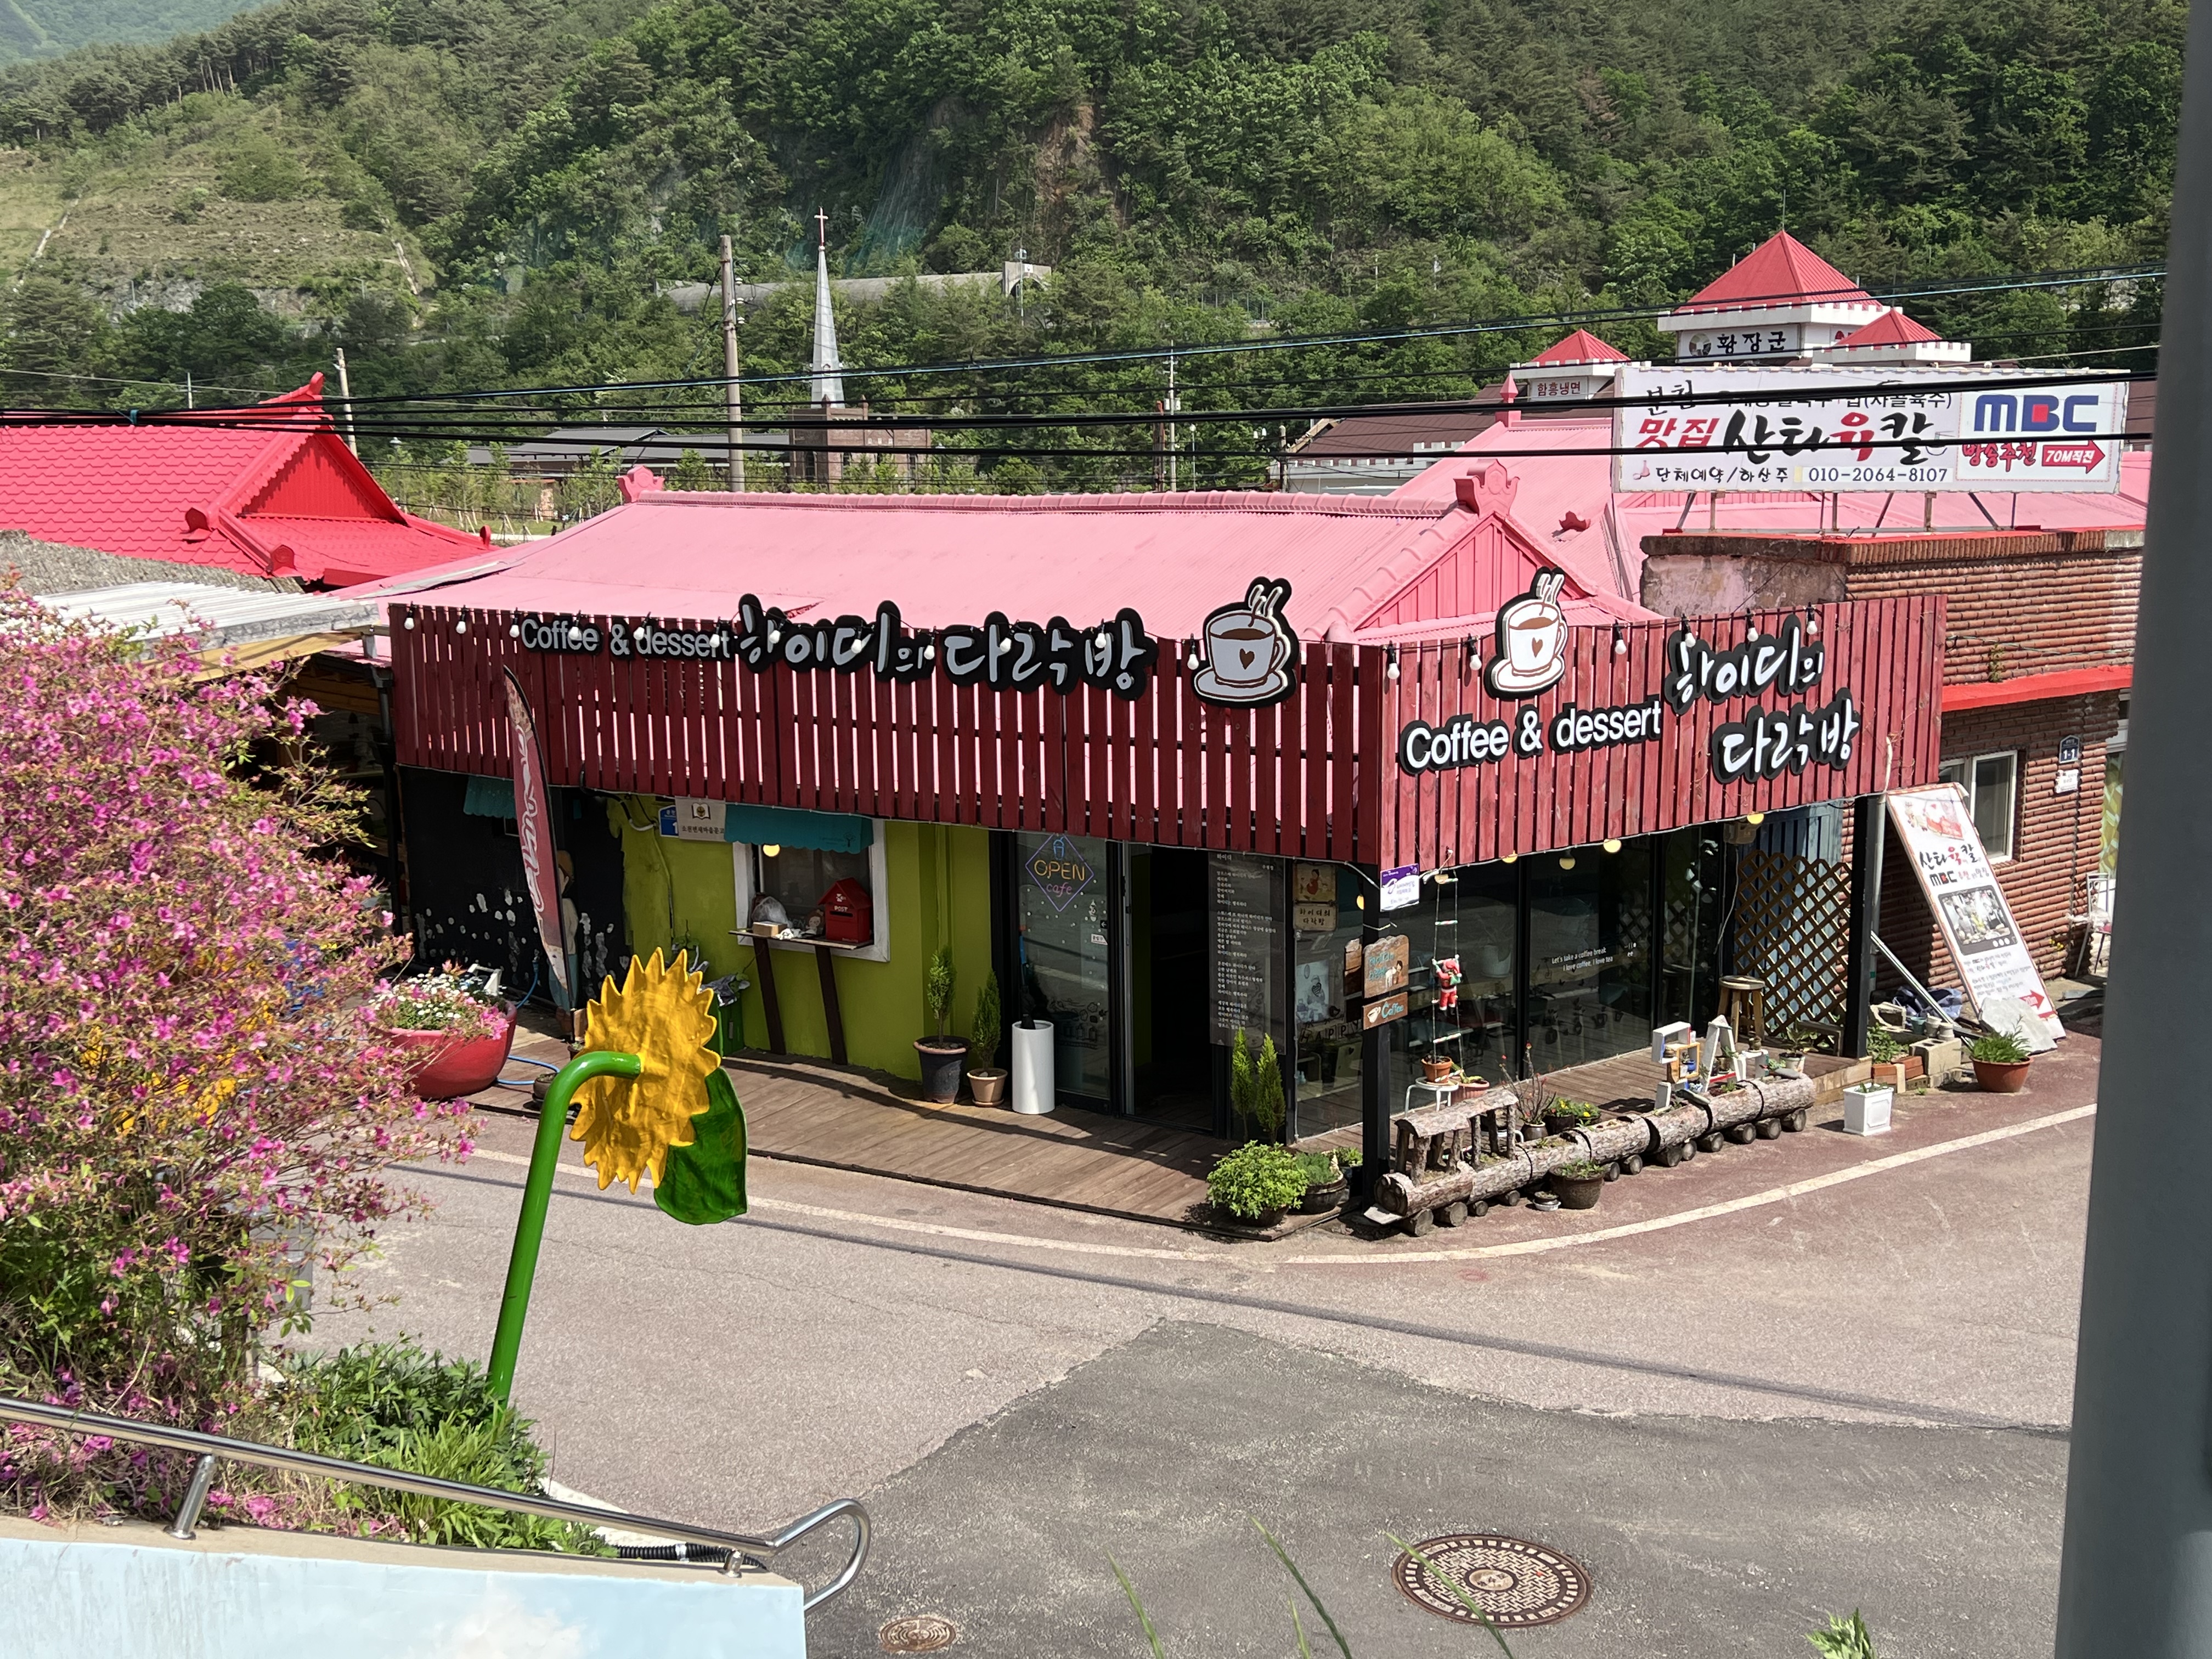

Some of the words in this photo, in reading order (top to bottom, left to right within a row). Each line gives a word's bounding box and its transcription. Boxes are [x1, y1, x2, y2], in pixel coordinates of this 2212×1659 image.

[1717, 331, 1786, 354] 황장군
[1537, 381, 1581, 397] 함흥냉면
[1973, 394, 2100, 433] MBC
[1635, 417, 1720, 449] 맛집
[1808, 467, 1948, 482] 010-2064-8107
[521, 618, 600, 651] Coffee
[610, 623, 630, 656] &
[944, 620, 1147, 690] 다락방
[1406, 720, 1509, 768] Coffee
[1519, 710, 1543, 752] &
[1556, 700, 1661, 748] dessert
[1723, 698, 1859, 773] 다락방
[1034, 859, 1085, 881] OPEN
[1929, 870, 1958, 887] MBC
[1046, 881, 1073, 898] cafe
[1551, 956, 1563, 964] Let's
[1563, 953, 1574, 962] take
[1578, 950, 1593, 958] coffee
[1593, 946, 1607, 956] break
[1381, 1001, 1405, 1019] Coffee
